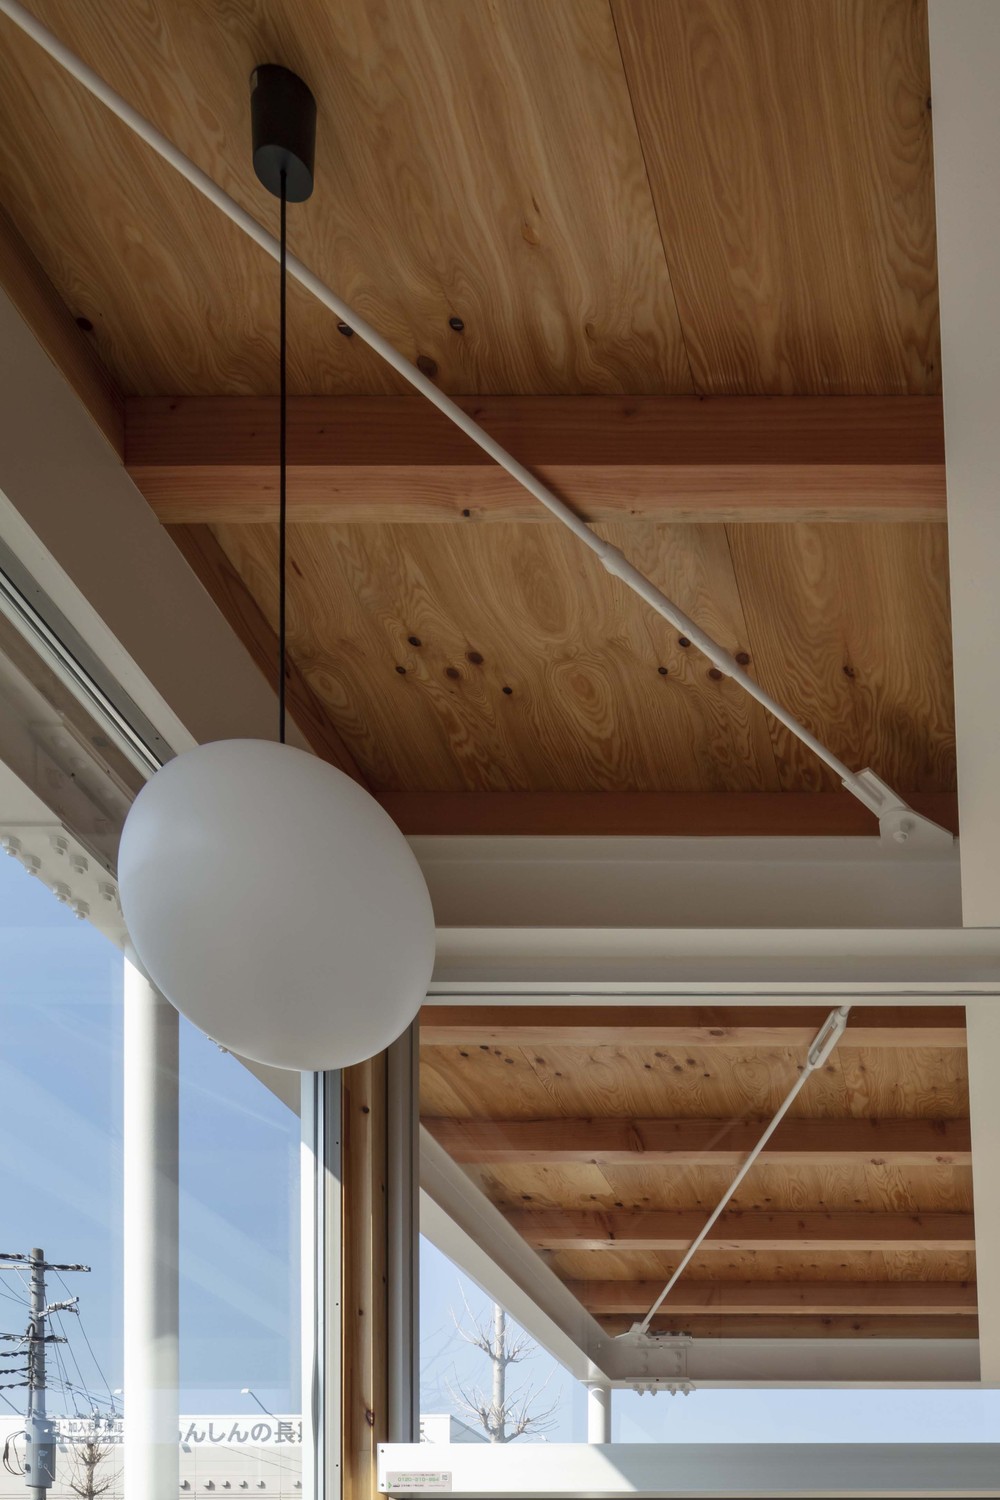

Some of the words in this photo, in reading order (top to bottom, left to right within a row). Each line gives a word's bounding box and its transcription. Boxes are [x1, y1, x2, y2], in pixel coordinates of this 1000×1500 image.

[179, 1421, 302, 1443] んしんの長
